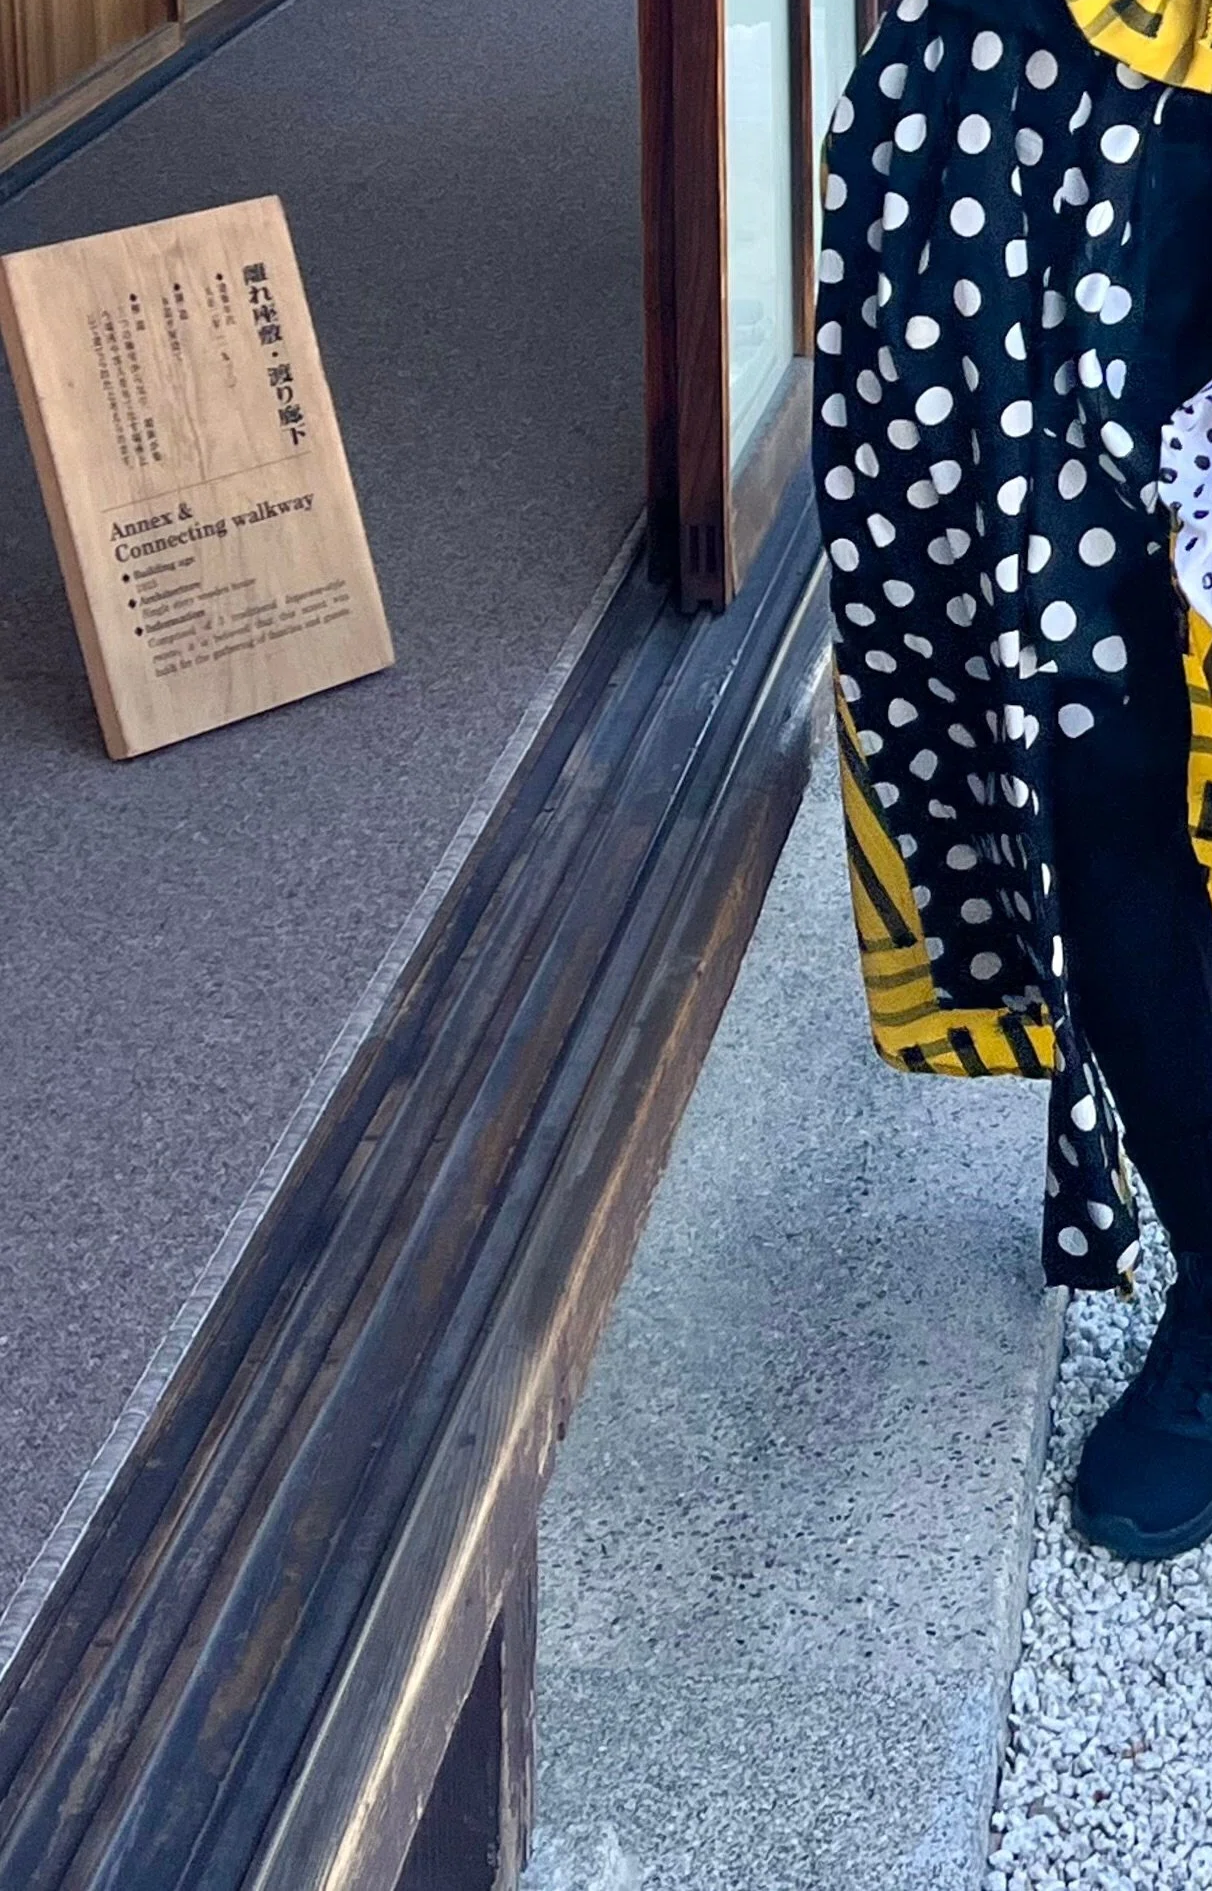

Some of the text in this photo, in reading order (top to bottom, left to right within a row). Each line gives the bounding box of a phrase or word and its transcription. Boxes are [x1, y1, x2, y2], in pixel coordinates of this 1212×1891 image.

[242, 262, 306, 446] 離れ座敷・渡り廊下
[110, 502, 193, 541] Annex &
[114, 493, 314, 563] Connecting walkway
